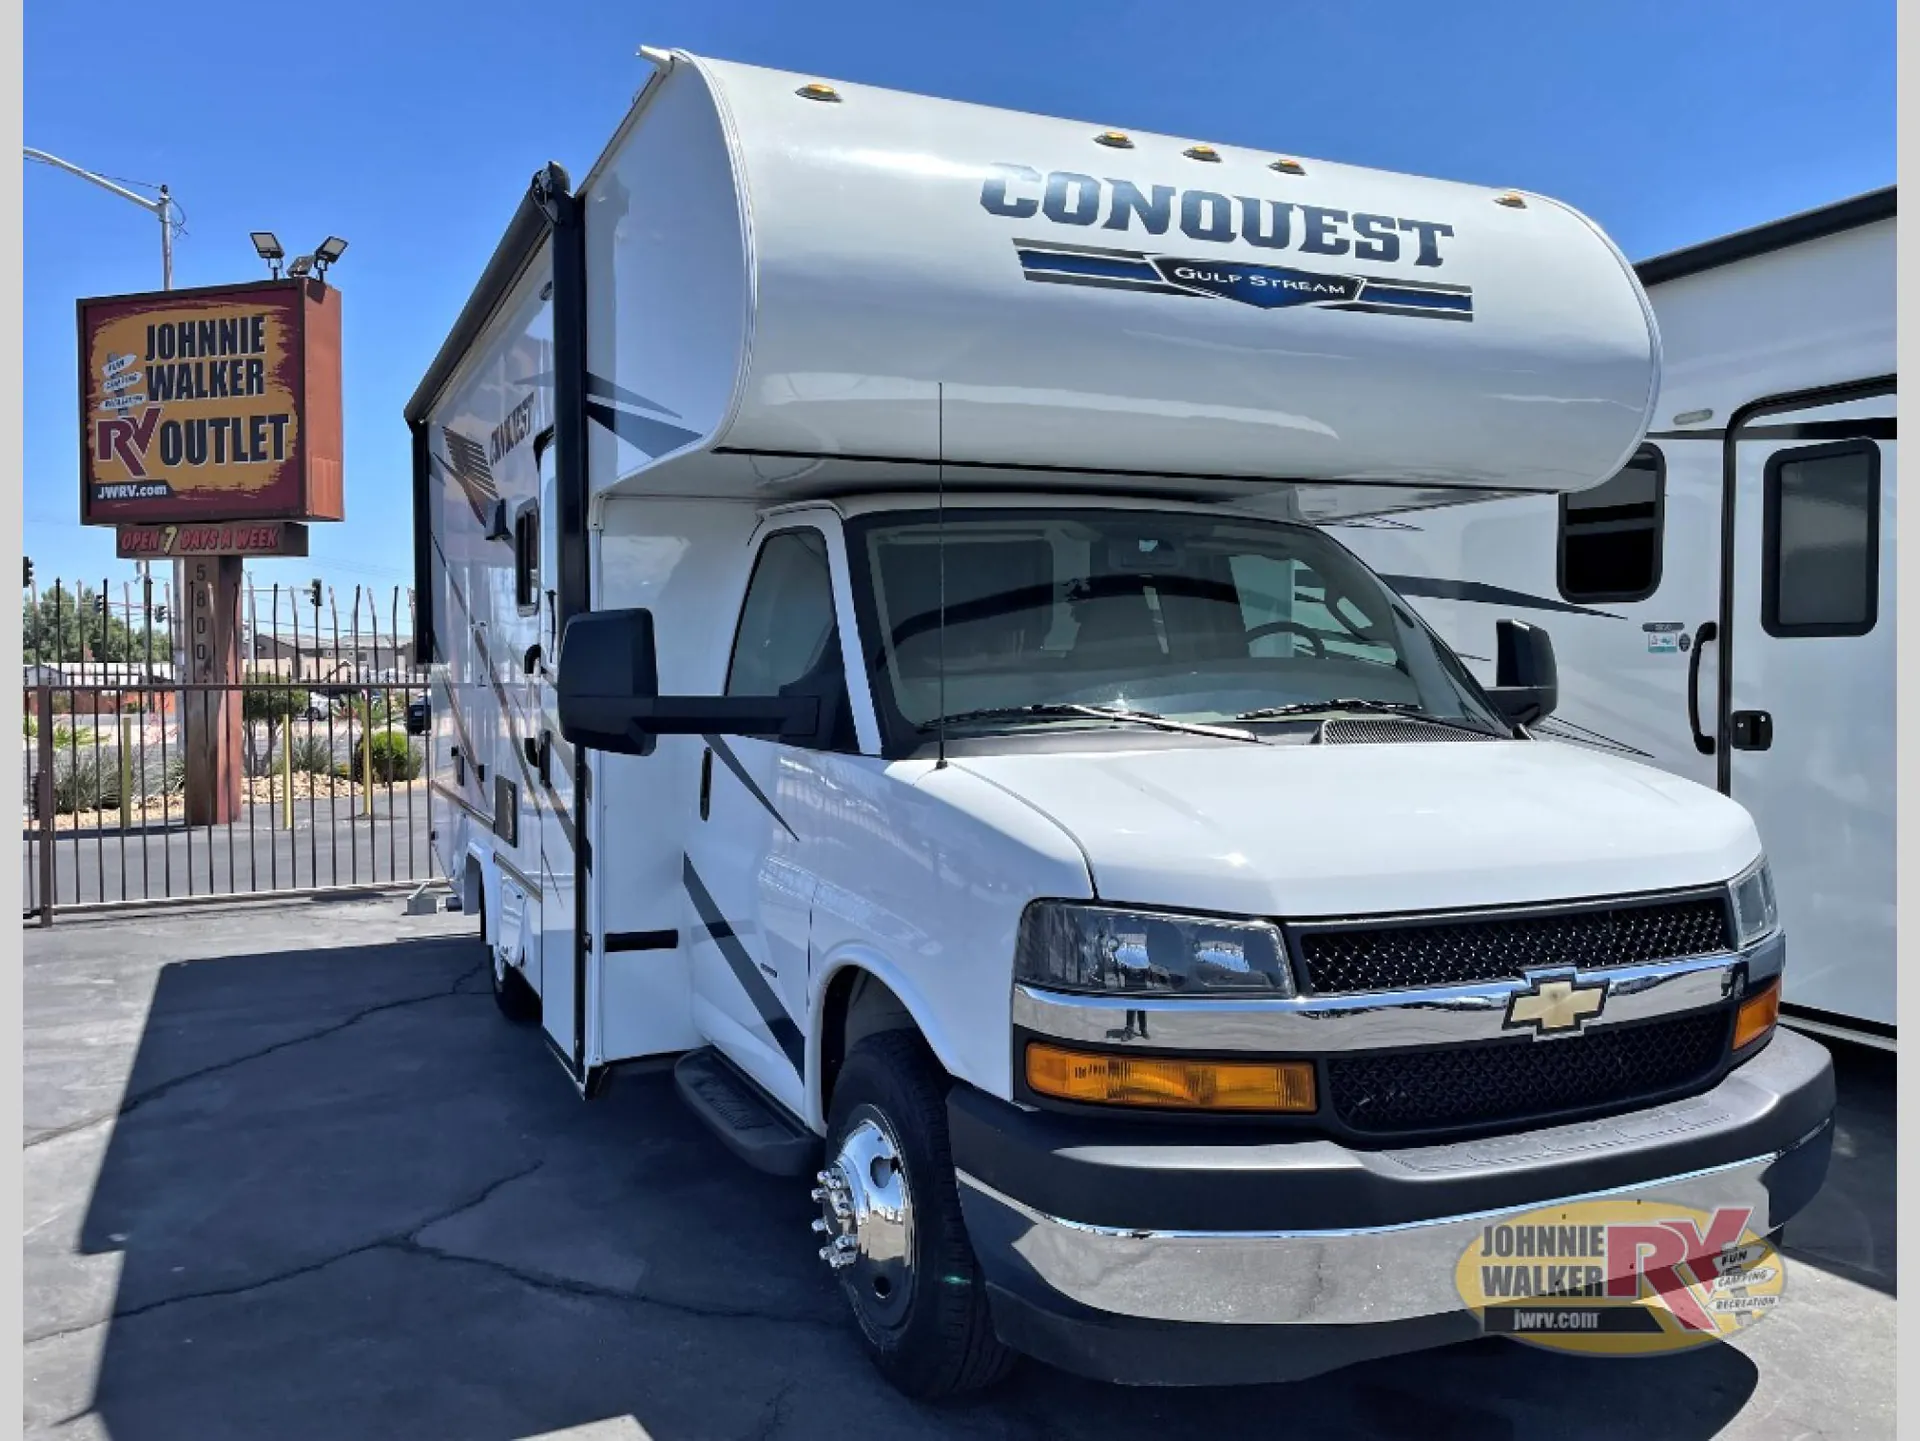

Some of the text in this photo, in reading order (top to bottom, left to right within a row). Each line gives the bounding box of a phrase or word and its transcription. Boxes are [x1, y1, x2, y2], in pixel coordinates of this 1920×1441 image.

[979, 162, 1455, 268] CONQUEST
[1249, 274, 1345, 295] STREAM
[145, 316, 266, 361] JOHNNIE
[146, 358, 264, 401] WALKER
[97, 406, 290, 478] RV OUTLET
[97, 484, 168, 499] JWRV.com
[121, 525, 280, 555] OPEN 7 DAYS A WEEK
